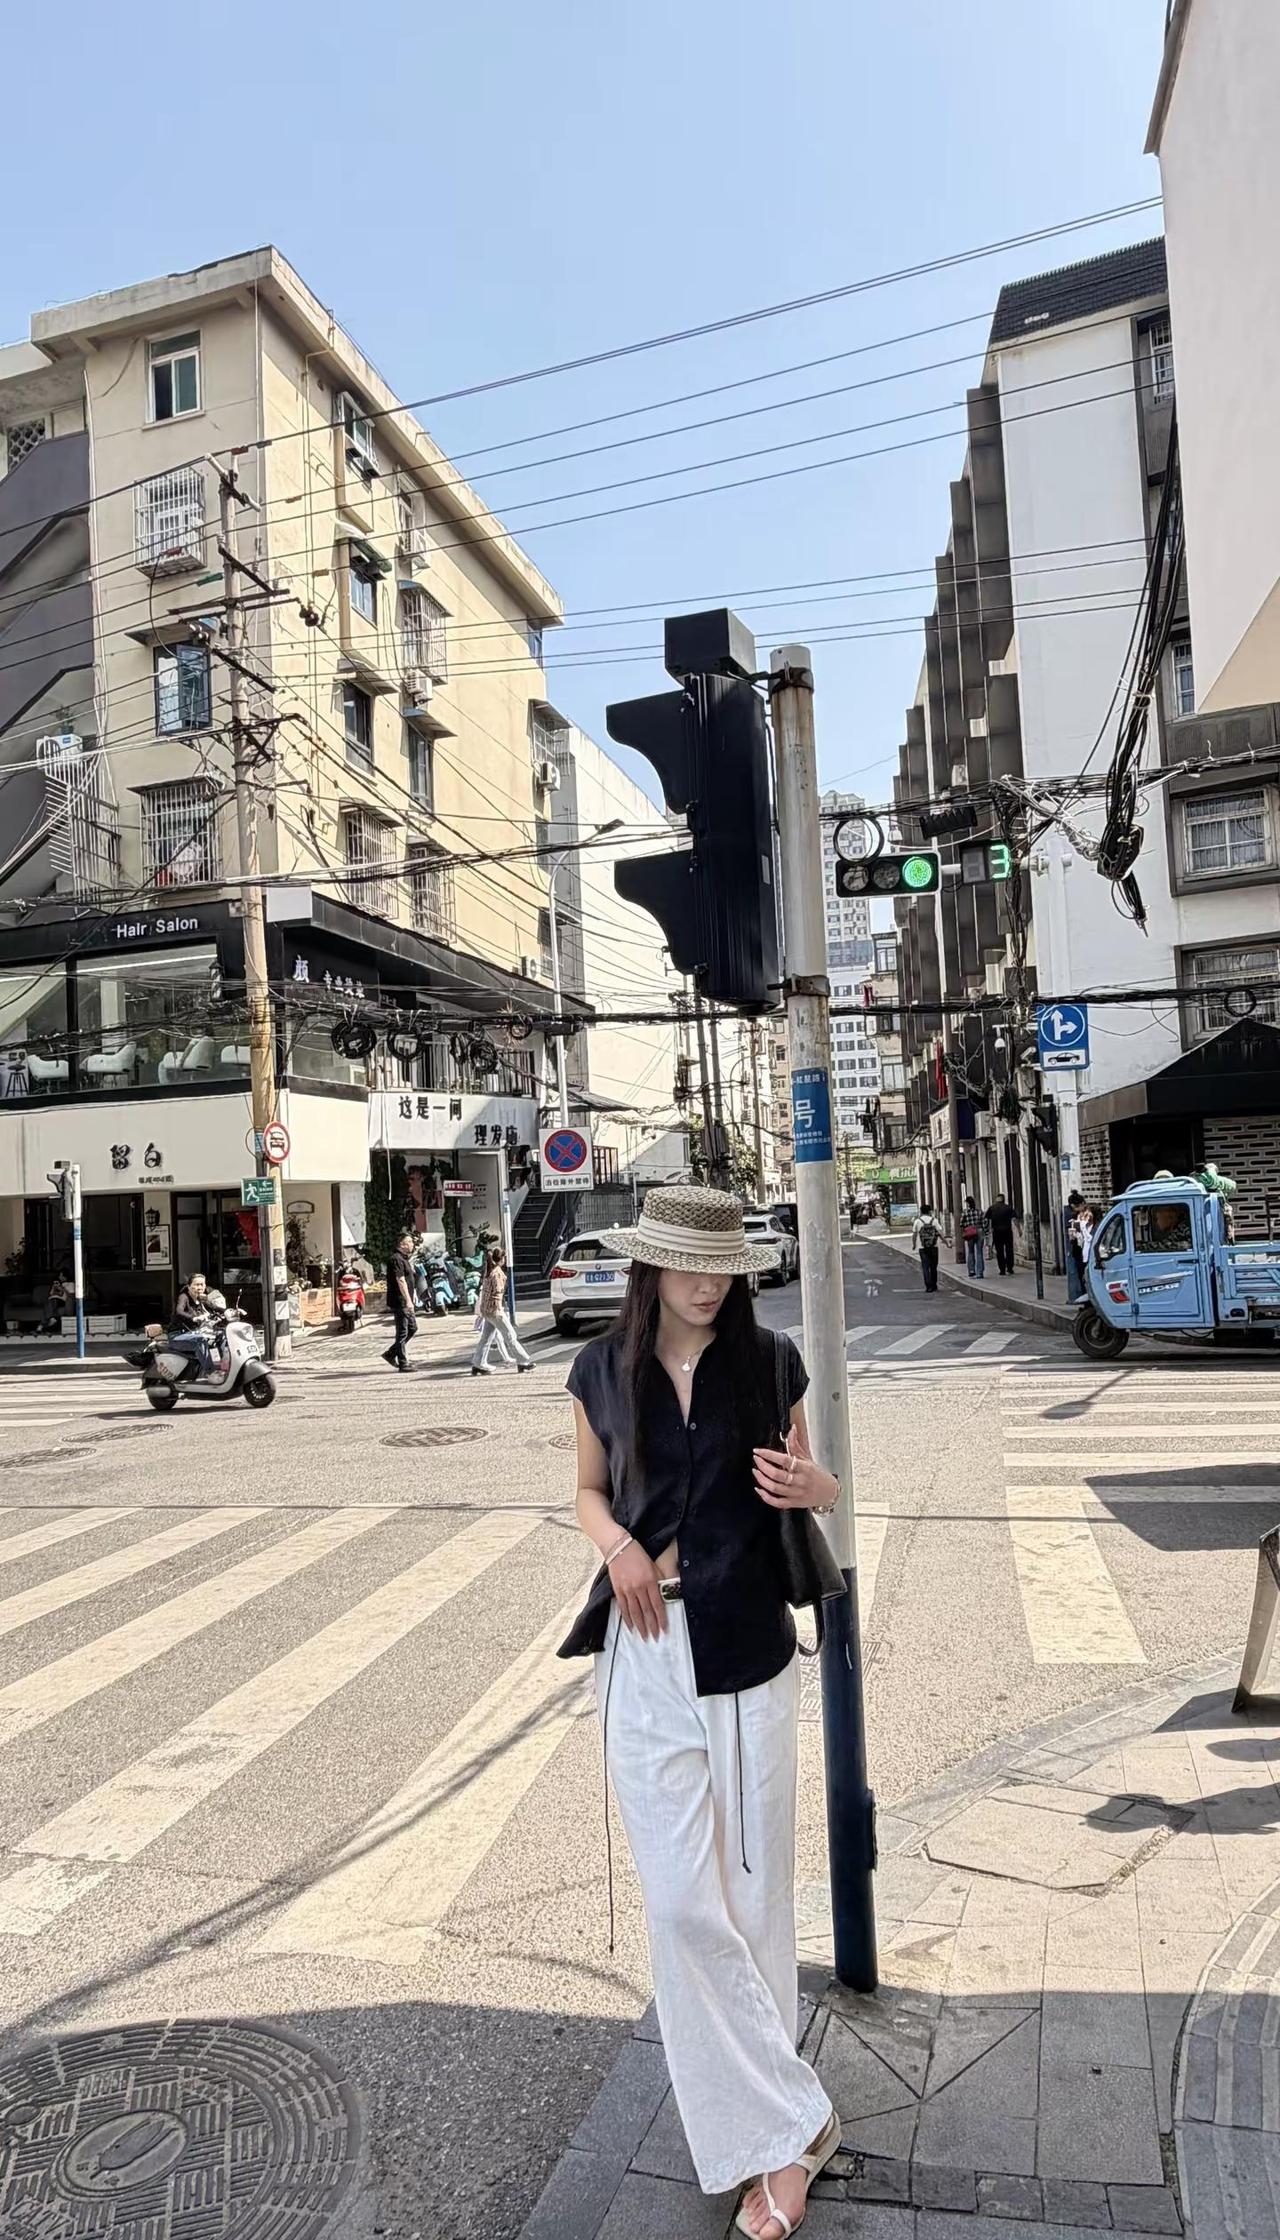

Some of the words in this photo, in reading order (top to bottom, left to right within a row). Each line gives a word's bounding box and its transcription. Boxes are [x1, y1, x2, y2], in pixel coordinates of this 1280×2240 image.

[990, 844, 1010, 878] 3
[116, 922, 147, 938] Hair
[155, 917, 198, 933] Salon
[398, 1096, 462, 1121] 这是一间
[794, 1099, 815, 1128] 号
[474, 1124, 518, 1146] 理发店
[9, 2200, 71, 2236] CATV
